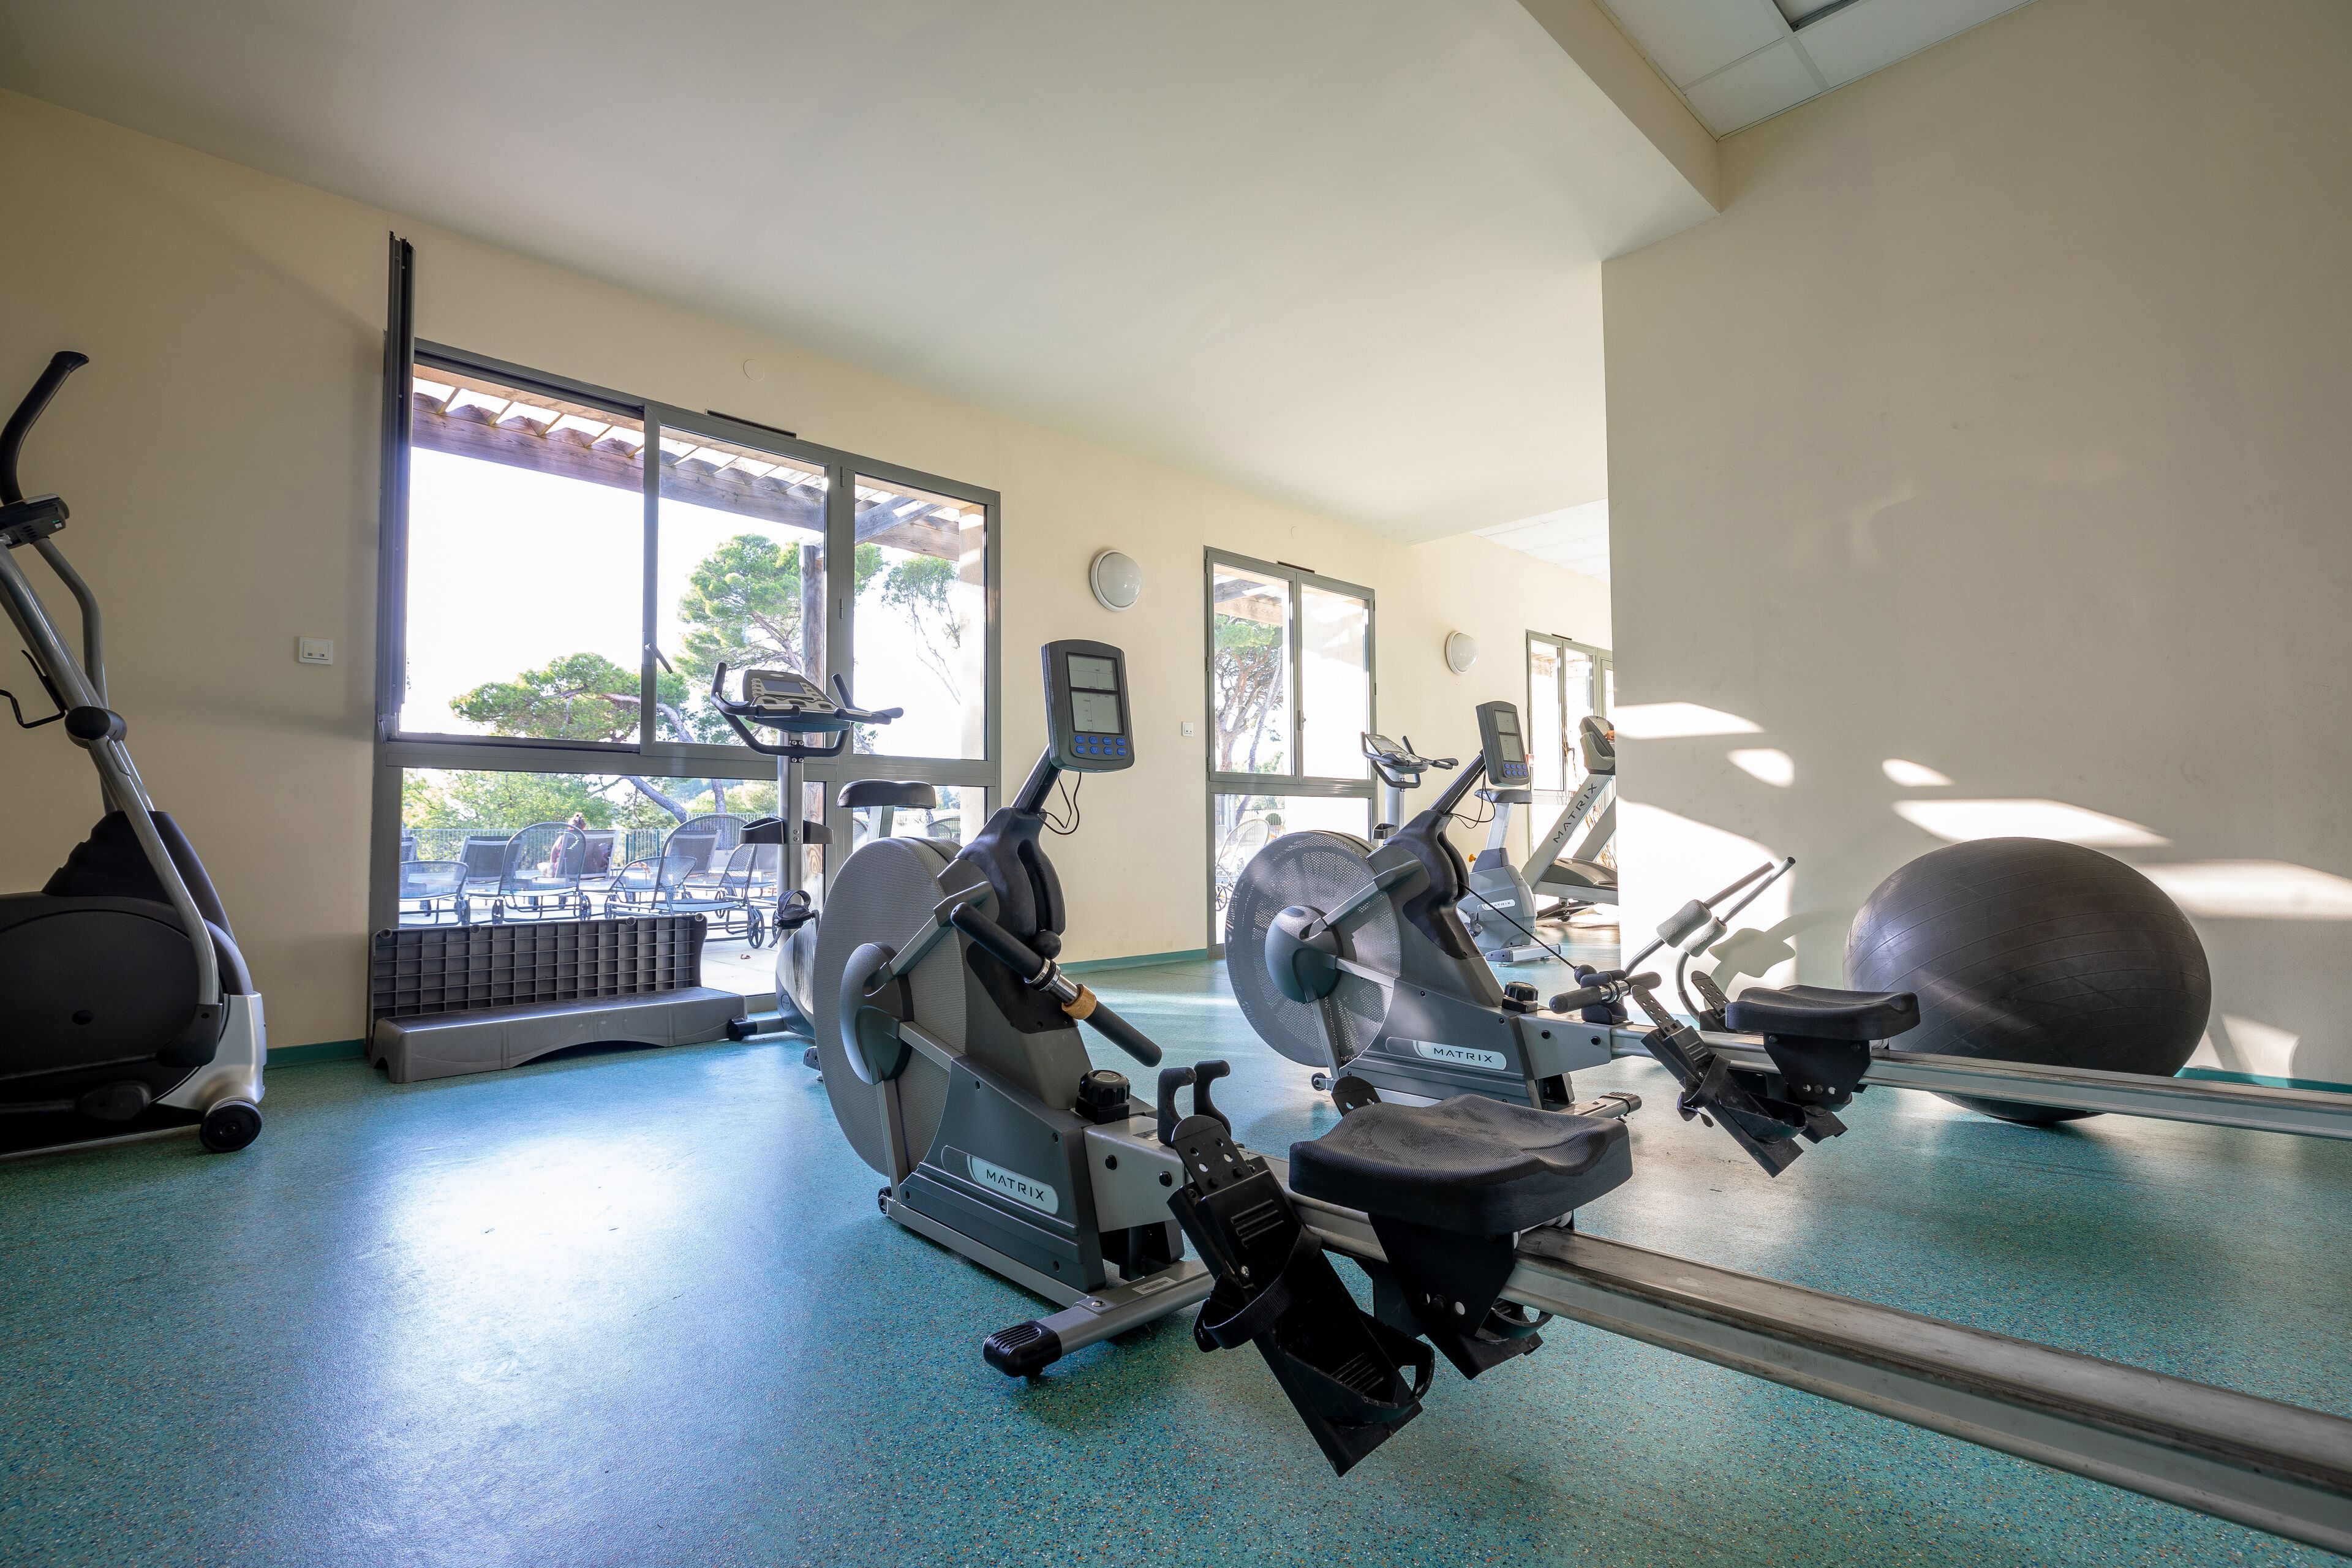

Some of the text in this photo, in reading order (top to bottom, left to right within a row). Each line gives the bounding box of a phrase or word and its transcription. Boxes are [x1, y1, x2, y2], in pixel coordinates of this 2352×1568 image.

[1553, 783, 1597, 843] MATRIX
[1433, 1047, 1493, 1063] MATRIX
[986, 1169, 1044, 1202] MATRIX
